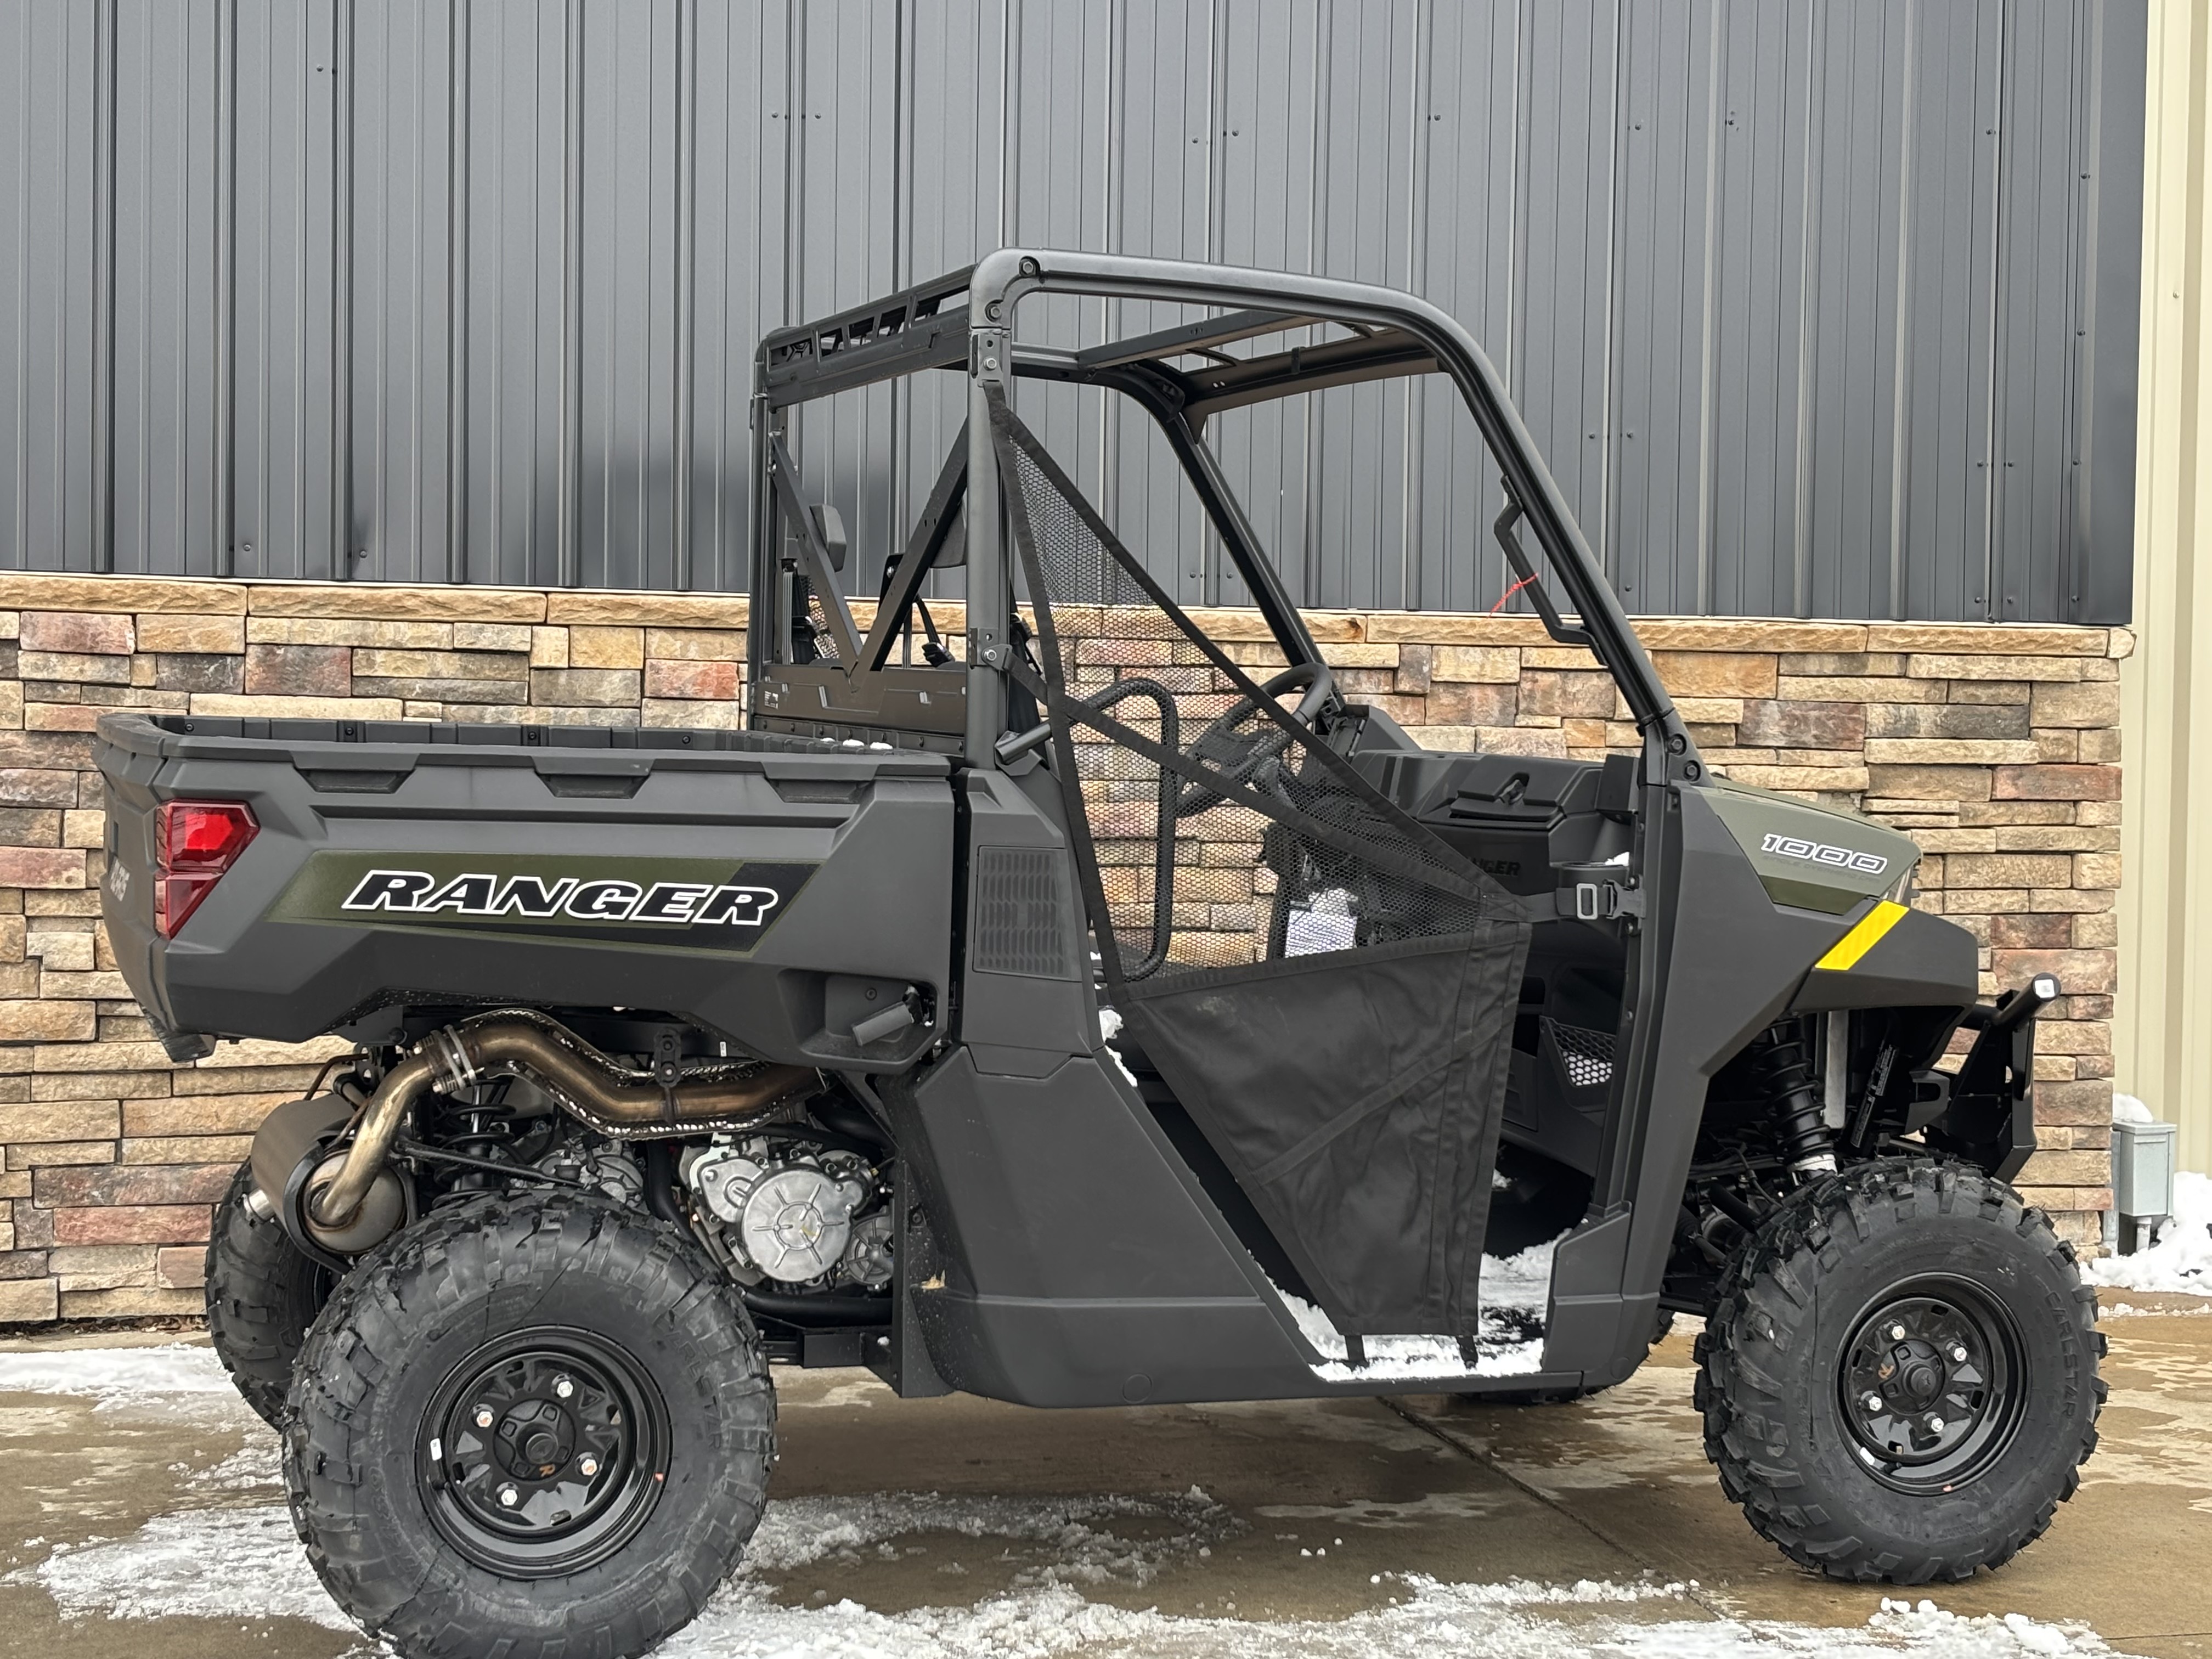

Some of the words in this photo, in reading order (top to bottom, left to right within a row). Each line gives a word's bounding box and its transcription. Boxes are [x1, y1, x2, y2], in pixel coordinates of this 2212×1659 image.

[1760, 833, 1888, 874] 1000
[341, 870, 778, 926] RANGER
[2045, 1290, 2079, 1418] CARLSTAR
